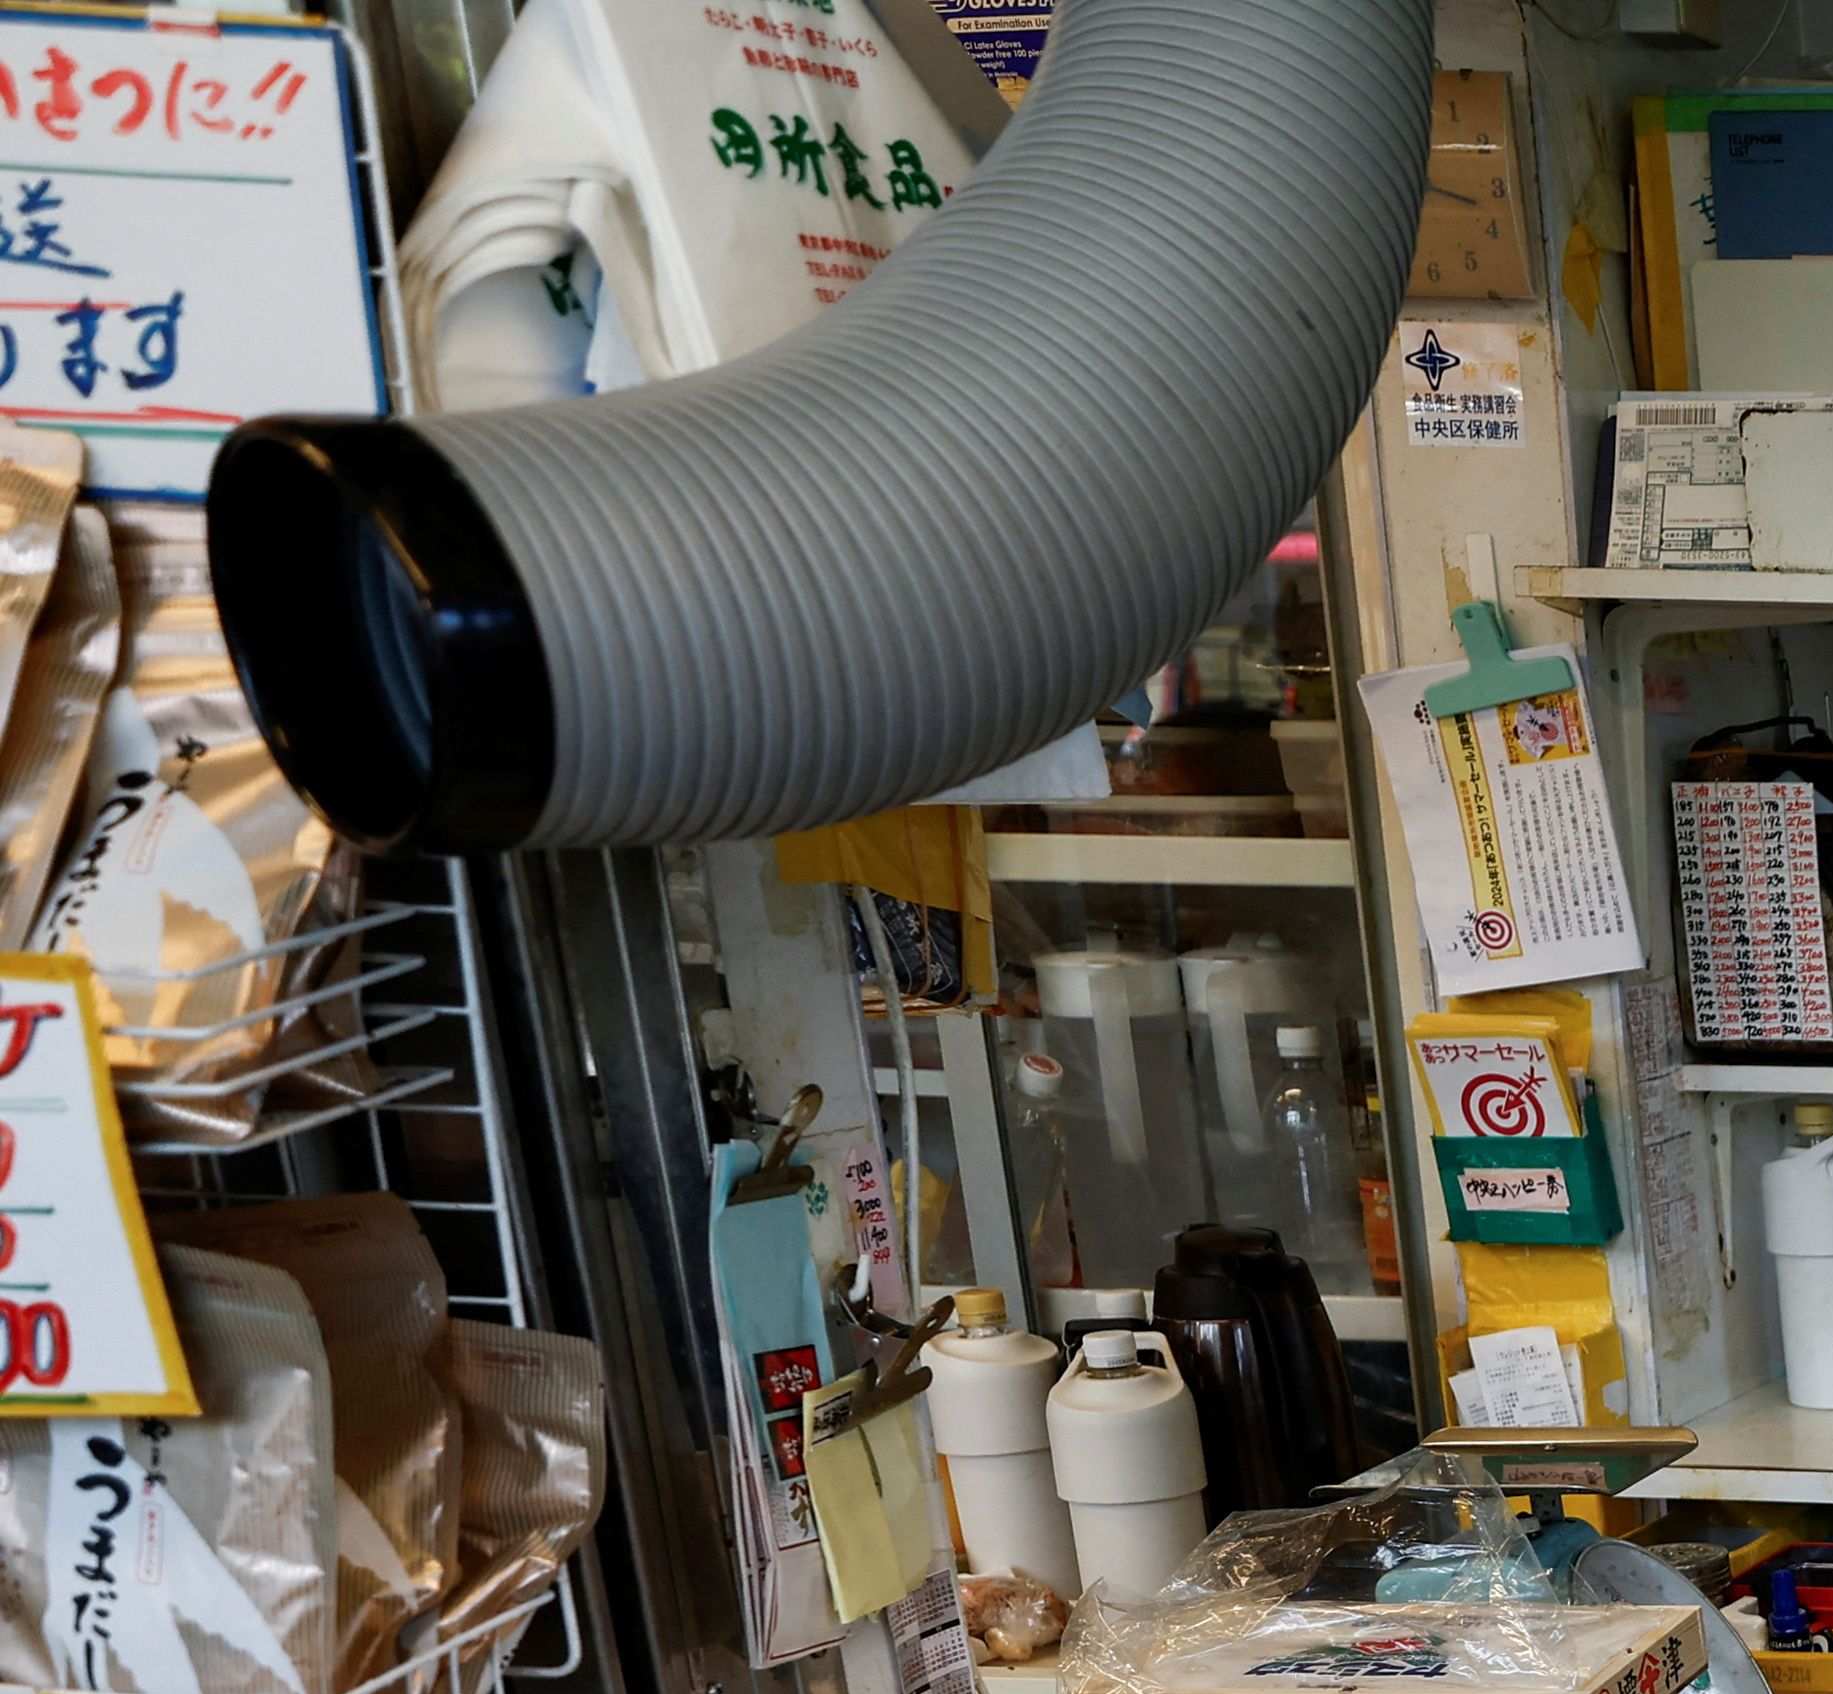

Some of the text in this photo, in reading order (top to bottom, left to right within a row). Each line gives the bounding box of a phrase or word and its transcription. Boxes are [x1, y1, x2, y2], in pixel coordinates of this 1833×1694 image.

[958, 20, 972, 30] For
[975, 19, 1033, 30] Examination
[1013, 49, 1027, 57] 100
[1447, 101, 1459, 122] 1
[1477, 133, 1492, 154] 2
[1727, 133, 1784, 145] TELEPHONE
[711, 107, 943, 212] 田所食品
[1729, 145, 1750, 157] LIST
[1491, 177, 1506, 199] 3
[1485, 219, 1499, 240] 4
[1427, 261, 1441, 282] 6
[1464, 250, 1478, 272] 5
[1413, 418, 1519, 441] 中央区保健所
[1444, 1045, 1545, 1063] サマーセール
[73, 1435, 132, 1691] うまだし
